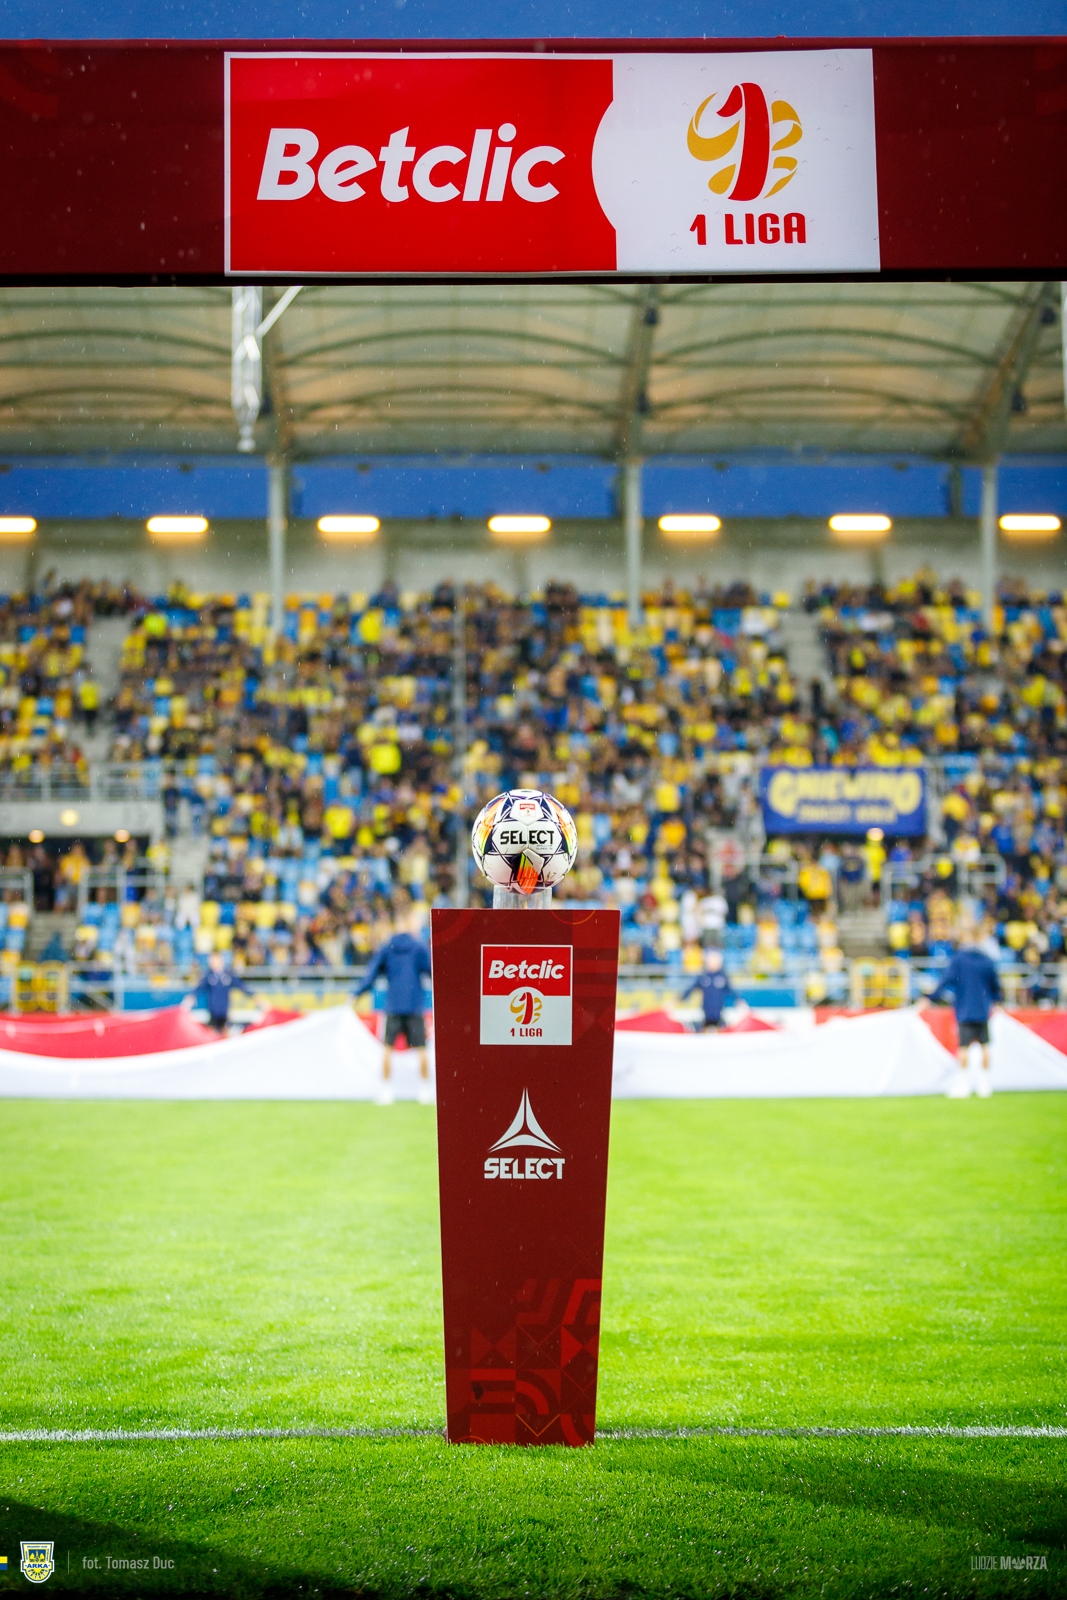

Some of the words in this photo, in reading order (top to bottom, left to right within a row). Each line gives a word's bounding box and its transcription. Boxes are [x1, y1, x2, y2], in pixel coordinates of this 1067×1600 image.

[256, 122, 566, 203] Betclic
[689, 213, 706, 245] 1
[724, 211, 807, 245] LIGA
[500, 830, 554, 845] SELECT
[488, 959, 565, 979] Betclic
[509, 1028, 515, 1038] 1
[519, 1027, 543, 1038] LIGA
[484, 1157, 566, 1180] SELECT
